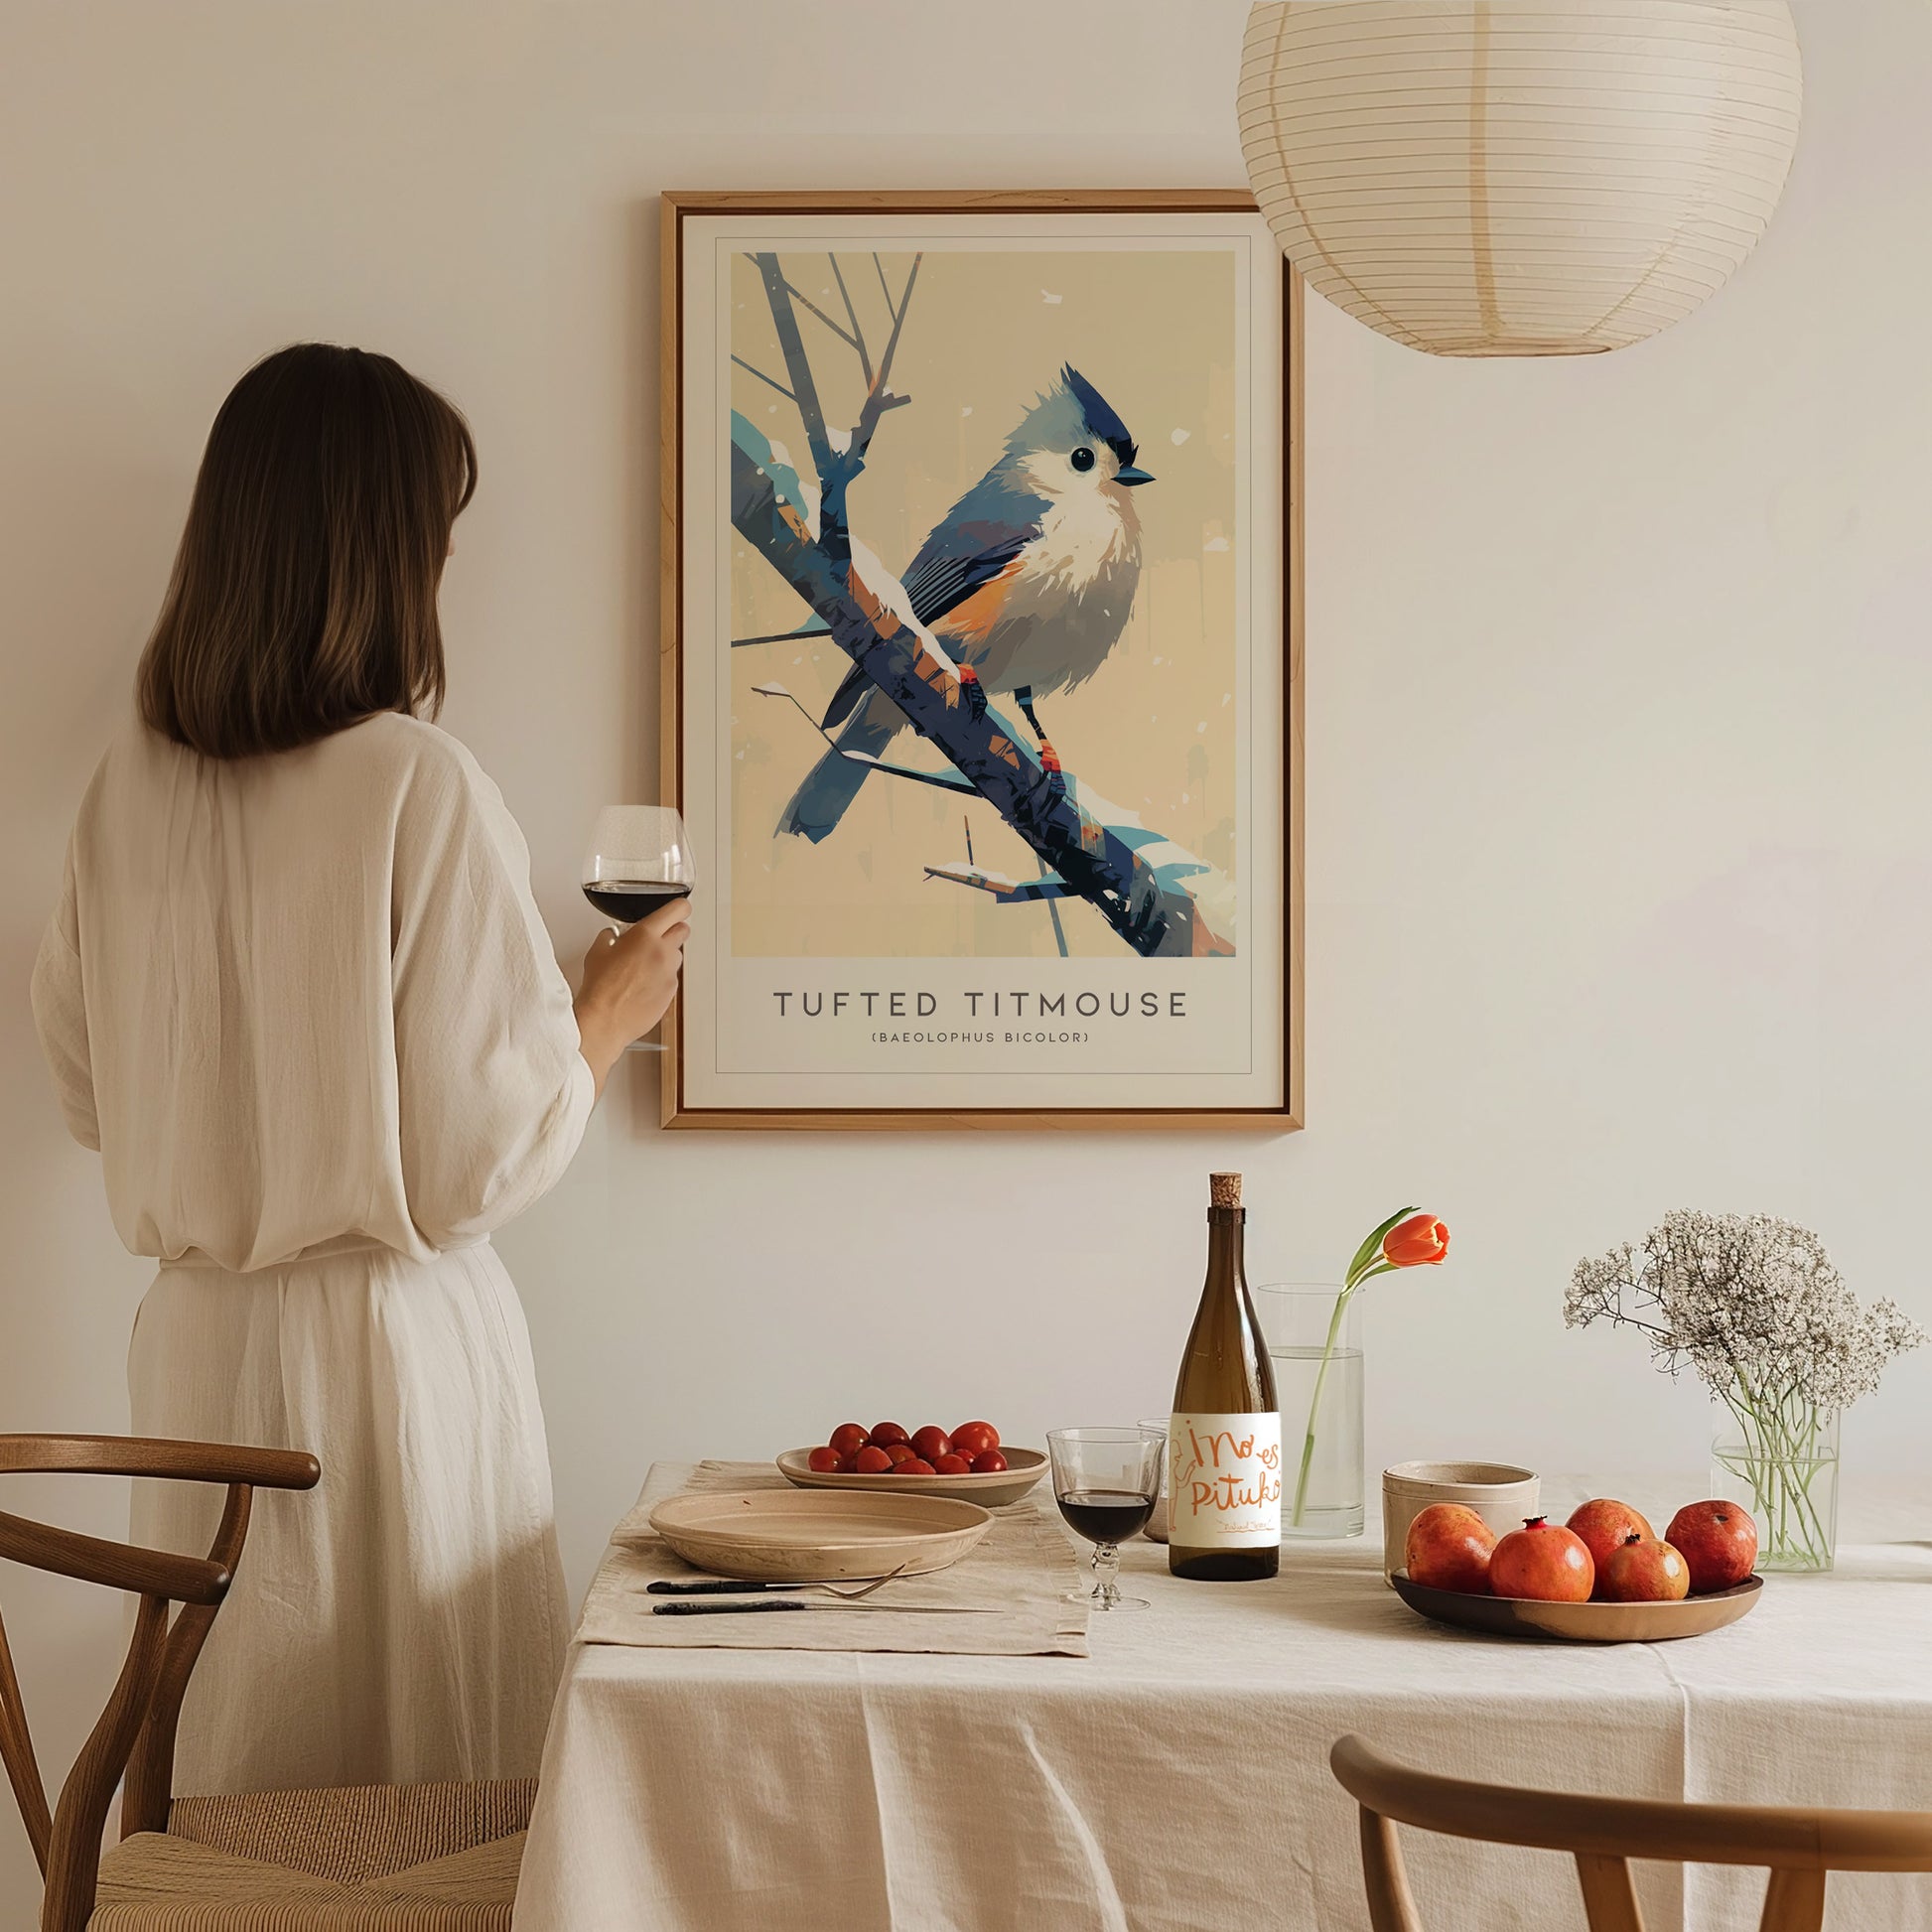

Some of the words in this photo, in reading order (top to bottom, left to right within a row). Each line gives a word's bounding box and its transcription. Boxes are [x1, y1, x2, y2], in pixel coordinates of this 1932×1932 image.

[772, 991, 937, 1018] TUFTED
[963, 991, 1186, 1018] TITMOUSE
[872, 1032, 995, 1043] (BAEOLOPHUS
[1004, 1032, 1089, 1043] BICOLOR)
[1256, 1444, 1280, 1470] es
